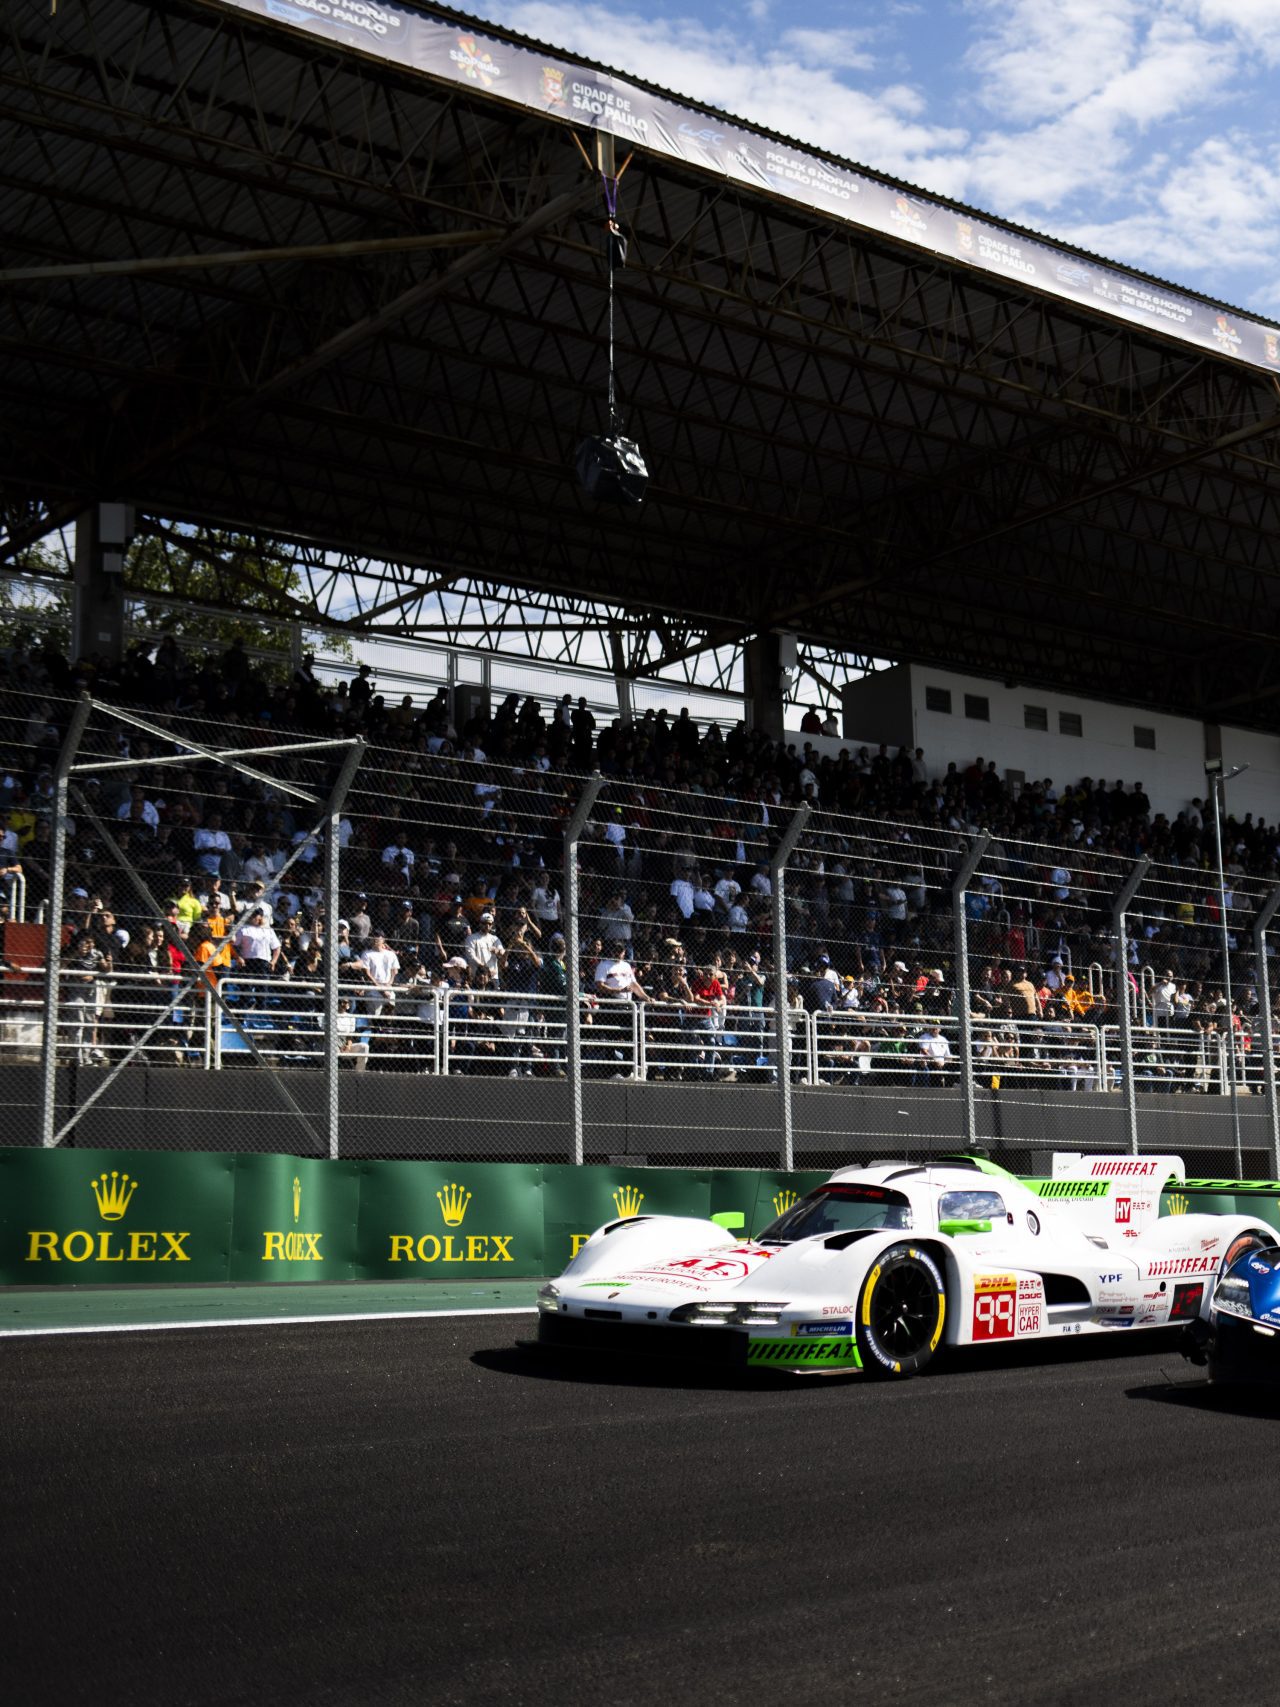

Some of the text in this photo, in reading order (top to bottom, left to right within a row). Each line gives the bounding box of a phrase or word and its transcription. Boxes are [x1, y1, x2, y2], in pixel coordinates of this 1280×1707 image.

[332, 9, 388, 35] PAULO
[572, 83, 632, 112] CIDADE DE
[572, 96, 649, 132] SÃO PAULO
[766, 151, 807, 173] ROLEX
[817, 170, 860, 193] HORAS
[766, 162, 851, 200] DE SÃO PAULO
[978, 235, 1022, 258] CIDADE DE
[979, 246, 1036, 275] SÃO PAULO
[1121, 285, 1153, 303] ROLEX
[1122, 294, 1136, 306] DE
[1156, 307, 1187, 324] PAULO
[1116, 1201, 1131, 1220] HY
[25, 1231, 191, 1261] ROLEX
[388, 1235, 514, 1261] ROLEX
[980, 1277, 1012, 1288] DHL
[1019, 1280, 1036, 1290] FAT
[1099, 1273, 1123, 1284] YPF
[822, 1306, 854, 1315] STALOC
[976, 1294, 1014, 1335] 99
[1019, 1315, 1039, 1331] CAR
[1020, 1306, 1040, 1316] HYPER
[865, 1329, 889, 1364] MICHELIN
